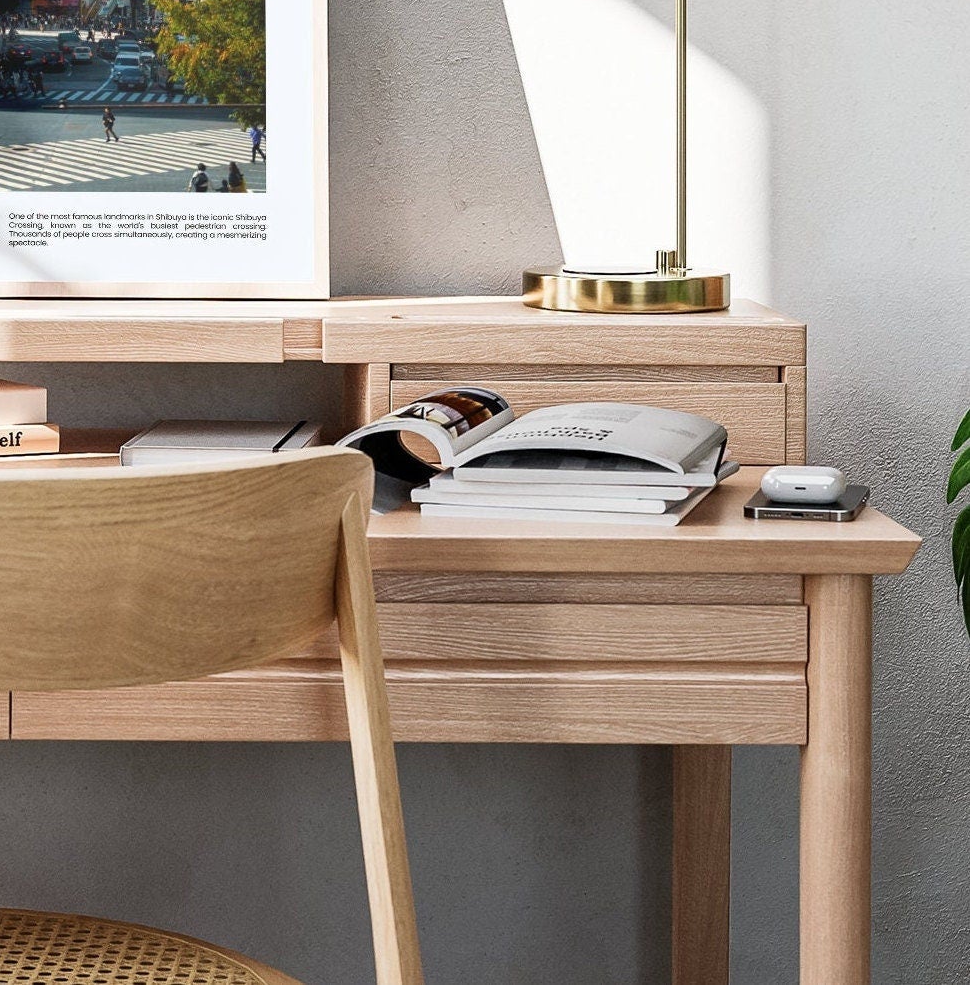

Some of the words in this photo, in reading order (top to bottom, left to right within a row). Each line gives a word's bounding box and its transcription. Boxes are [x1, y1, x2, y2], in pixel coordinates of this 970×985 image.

[236, 214, 266, 222] Shibuya
[9, 221, 44, 230] Crossing,
[50, 221, 76, 230] known
[231, 222, 267, 230] crossing.
[63, 230, 90, 238] people
[114, 231, 173, 239] simultaneously,
[175, 230, 208, 240] creating
[217, 231, 266, 240] mesmerizing
